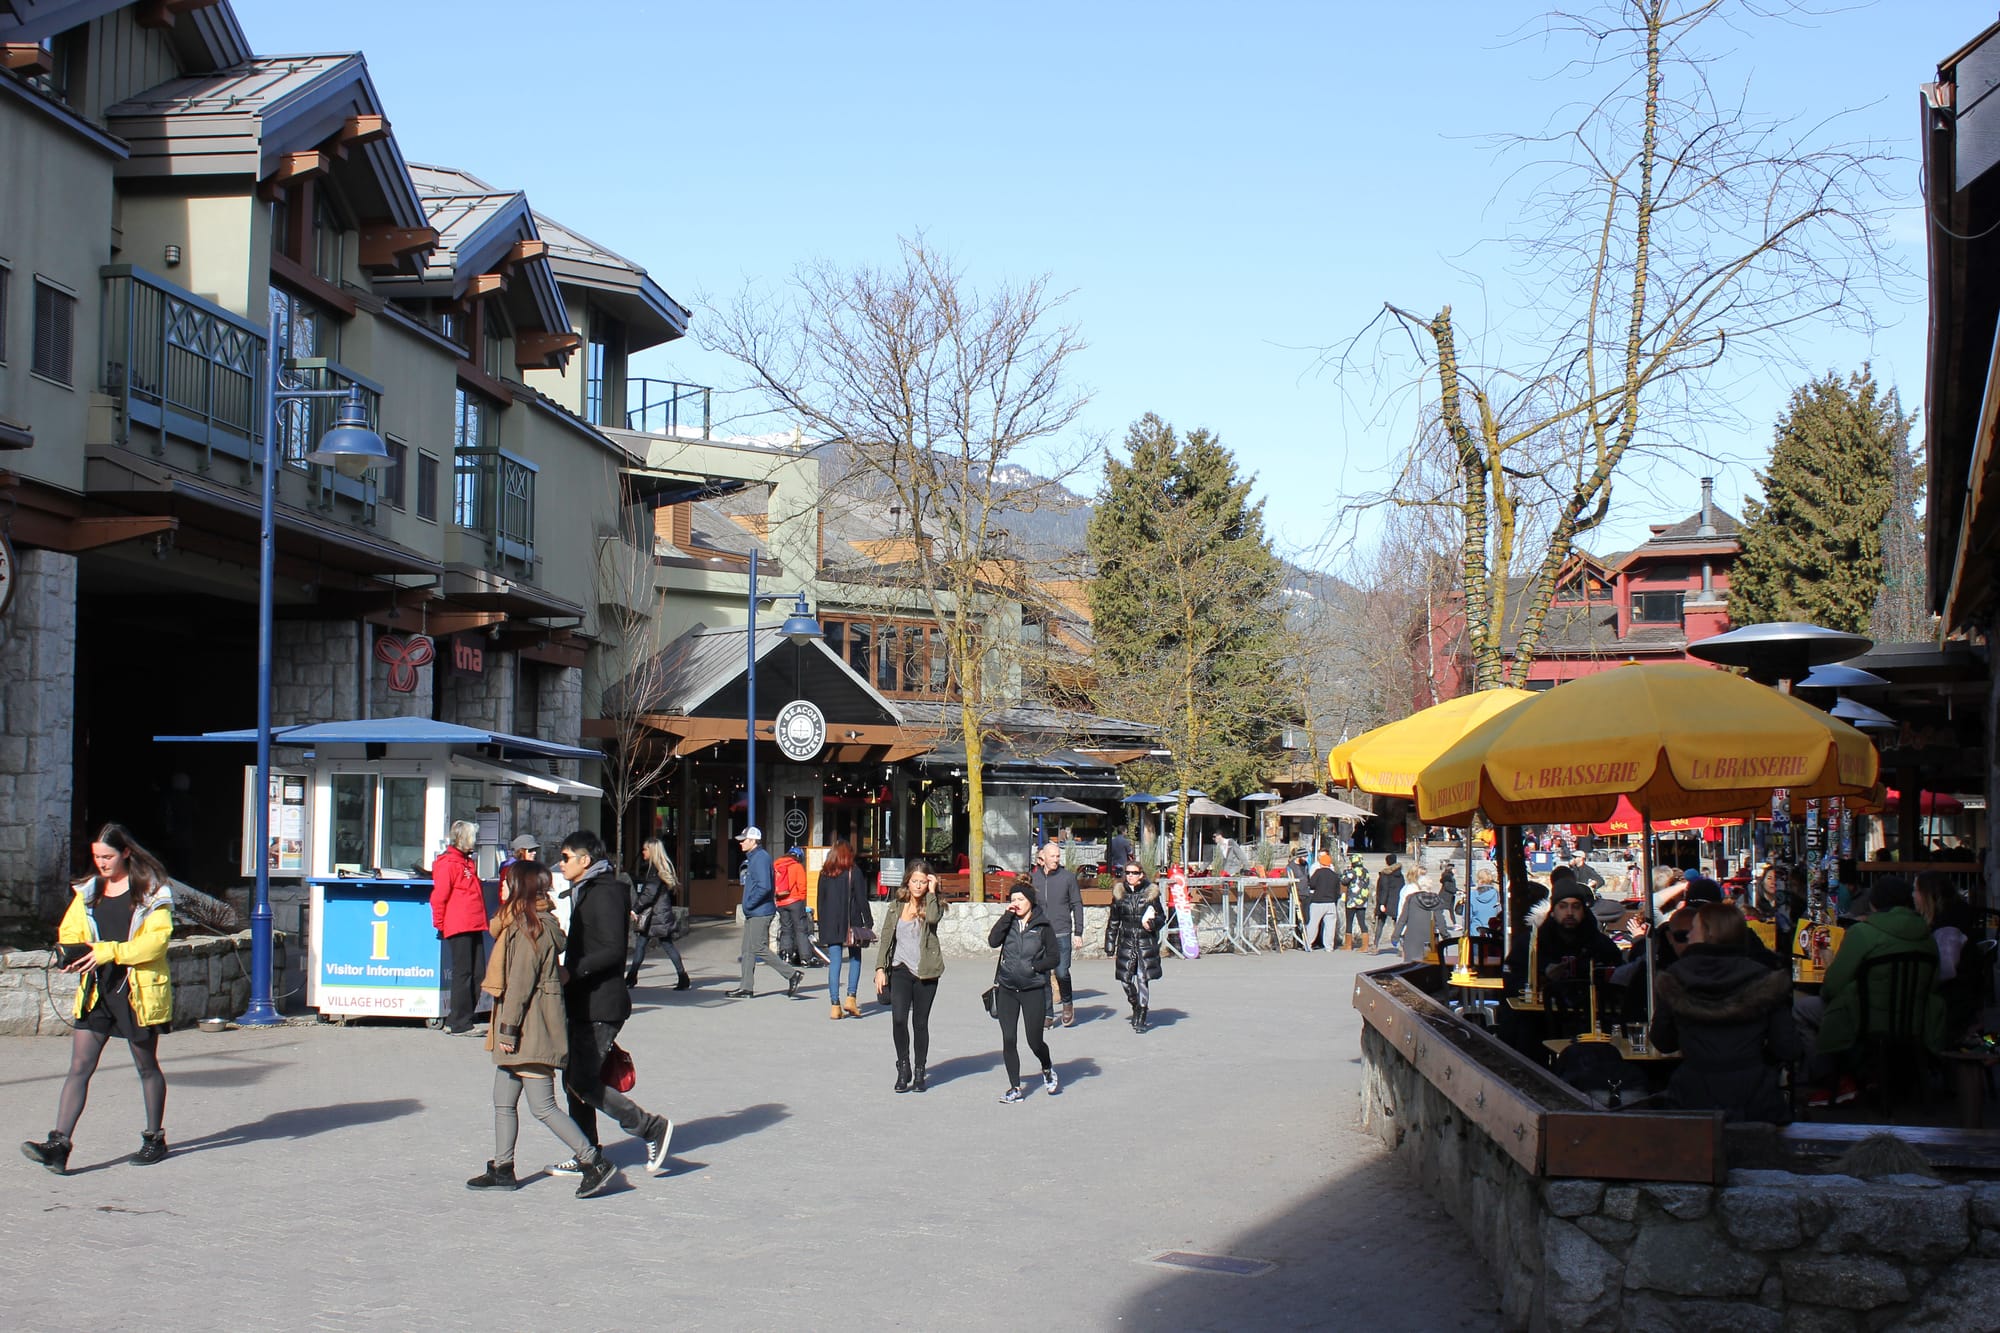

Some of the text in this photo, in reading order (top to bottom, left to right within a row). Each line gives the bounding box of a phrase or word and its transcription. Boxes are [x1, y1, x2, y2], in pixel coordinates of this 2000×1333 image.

[455, 639, 482, 672] tna
[784, 706, 818, 721] BEACON
[1538, 762, 1640, 789] BRASSERIE
[1714, 756, 1808, 779] BRASSERIE
[326, 963, 364, 976] Visitor
[366, 965, 434, 978] Information
[327, 996, 405, 1009] VILLAGE HOST
